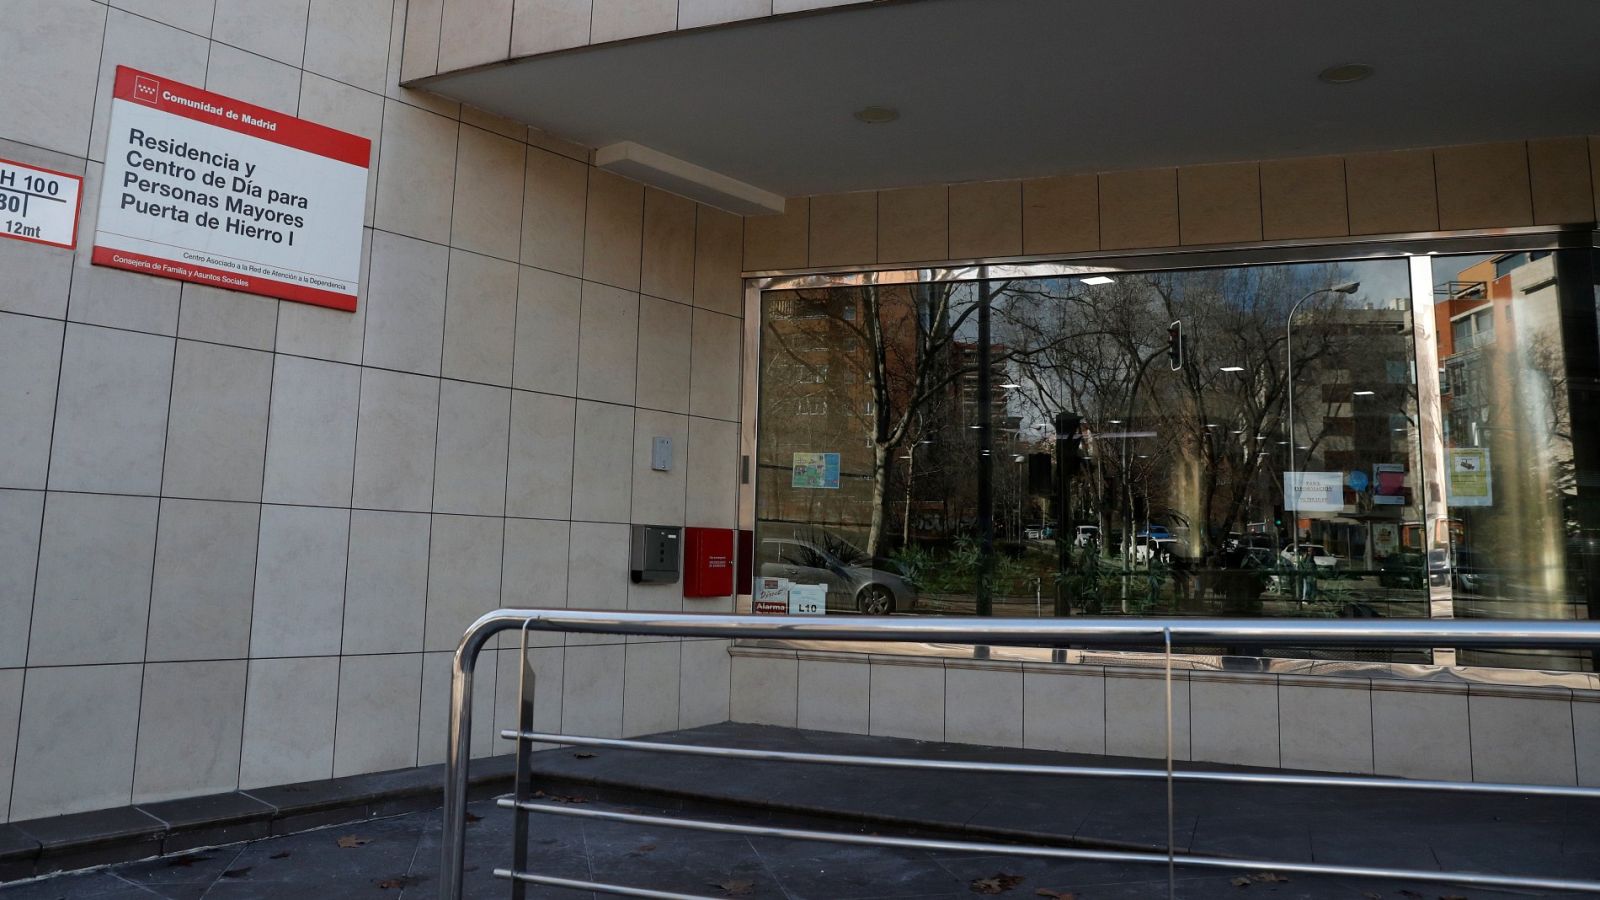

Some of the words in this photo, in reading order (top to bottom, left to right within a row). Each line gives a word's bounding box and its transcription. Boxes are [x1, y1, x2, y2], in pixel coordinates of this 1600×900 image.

[162, 91, 224, 116] Comunidad
[226, 110, 239, 121] de
[241, 114, 277, 131] Madrid
[129, 128, 239, 171] Residencia
[244, 162, 256, 178] y
[24, 175, 59, 196] 100
[126, 150, 196, 181] Centro
[202, 171, 226, 189] de
[232, 176, 262, 198] Día
[268, 189, 308, 209] para
[123, 171, 219, 208] Personas
[225, 196, 304, 228] Mayores
[6, 220, 41, 238] 12mt
[121, 192, 189, 223] Puerta
[195, 211, 220, 230] de
[226, 217, 283, 244] Hierro
[288, 231, 294, 246] I
[113, 254, 151, 269] Consejería
[152, 262, 162, 270] de
[162, 264, 187, 275] Familia
[194, 270, 221, 281] Asuntos
[222, 275, 249, 287] Sociales
[183, 252, 205, 262] Centro
[206, 257, 236, 268] Asociado
[249, 265, 262, 273] Red
[272, 270, 298, 280] Atención
[309, 277, 346, 290] Dependencia
[756, 602, 785, 611] Alarma
[799, 604, 816, 613] L10
